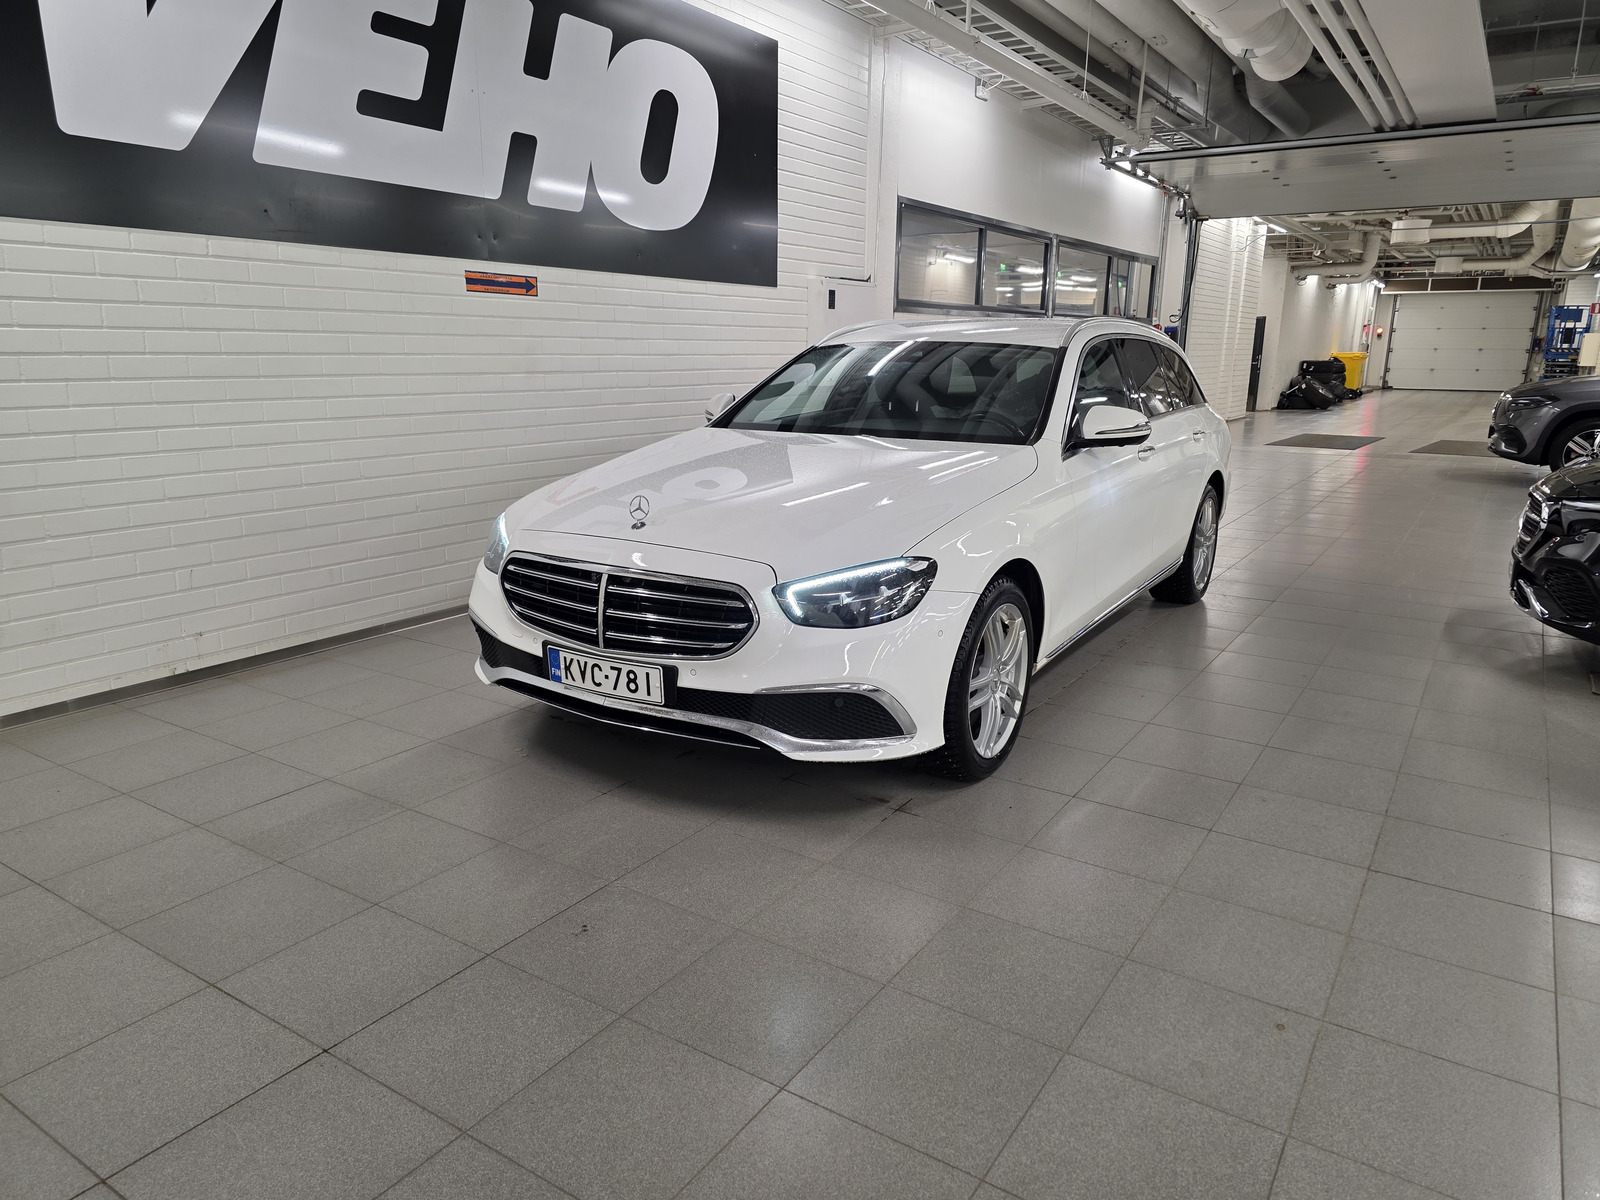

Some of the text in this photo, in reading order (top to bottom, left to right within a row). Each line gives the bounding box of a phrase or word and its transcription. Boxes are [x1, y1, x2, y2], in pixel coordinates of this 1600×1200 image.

[38, 0, 719, 231] VEHO
[551, 667, 561, 677] FIN
[563, 656, 651, 697] KVC-781
